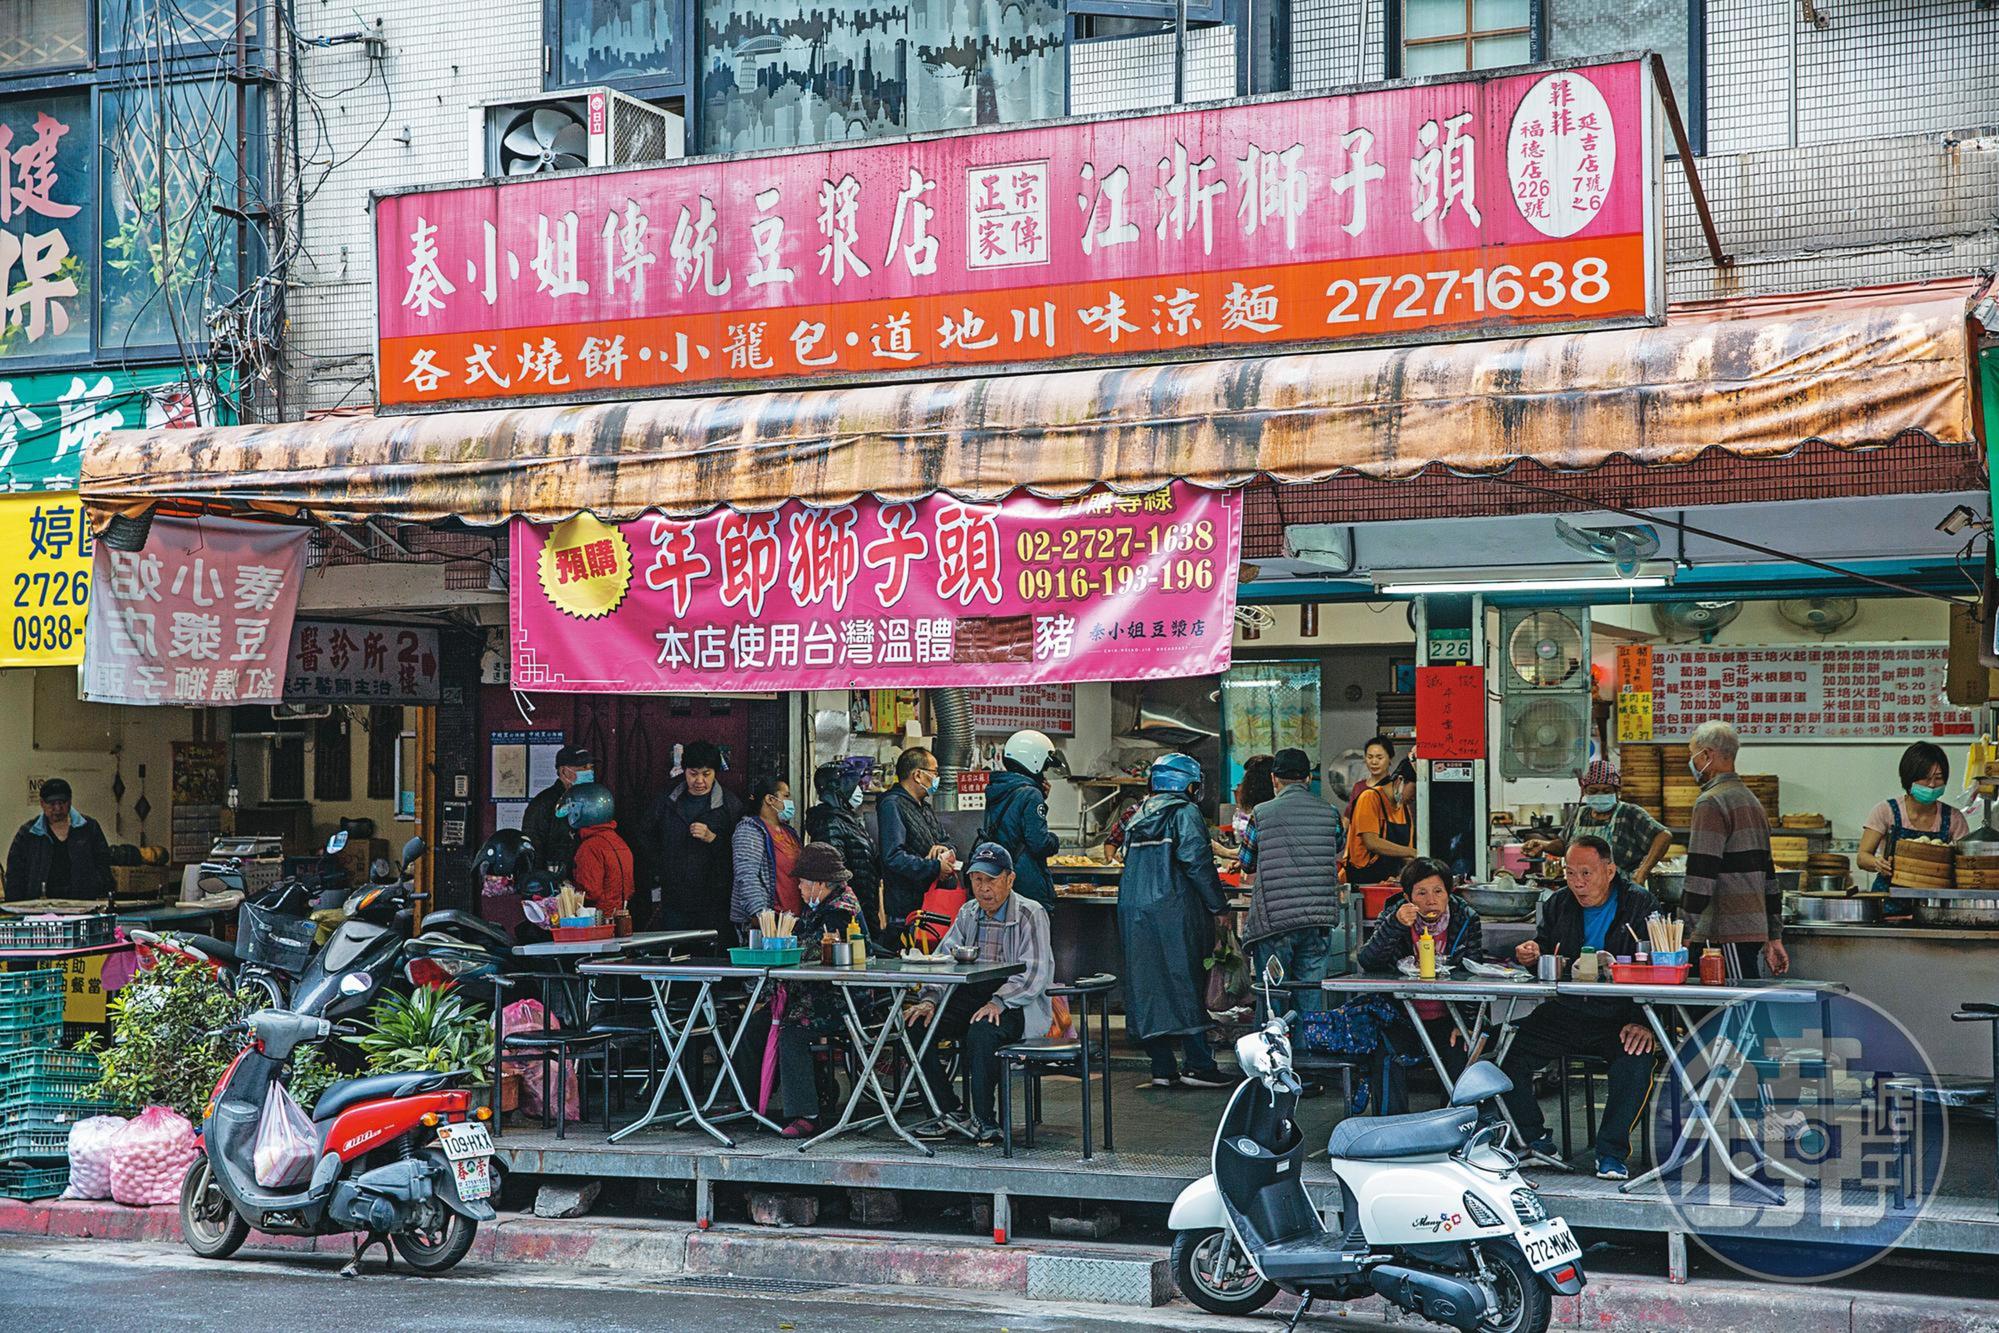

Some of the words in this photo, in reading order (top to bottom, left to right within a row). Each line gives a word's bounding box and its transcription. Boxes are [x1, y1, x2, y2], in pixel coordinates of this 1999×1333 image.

[592, 112, 602, 133] 日立
[975, 172, 1040, 214] 正宗
[1077, 111, 1482, 257] 江浙獅子頭
[401, 167, 940, 318] 秦小姐傳統豆漿店
[975, 217, 1043, 260] 家傳
[555, 538, 619, 586] 預購
[645, 503, 1003, 619] 年節獅子頭
[1017, 520, 1214, 562] 02-2727-1638
[1018, 559, 1214, 600] 0916-193-196
[296, 626, 389, 673] 醫診所
[1089, 619, 1206, 642] 秦小姐豆漿店
[1430, 641, 1470, 657] 226
